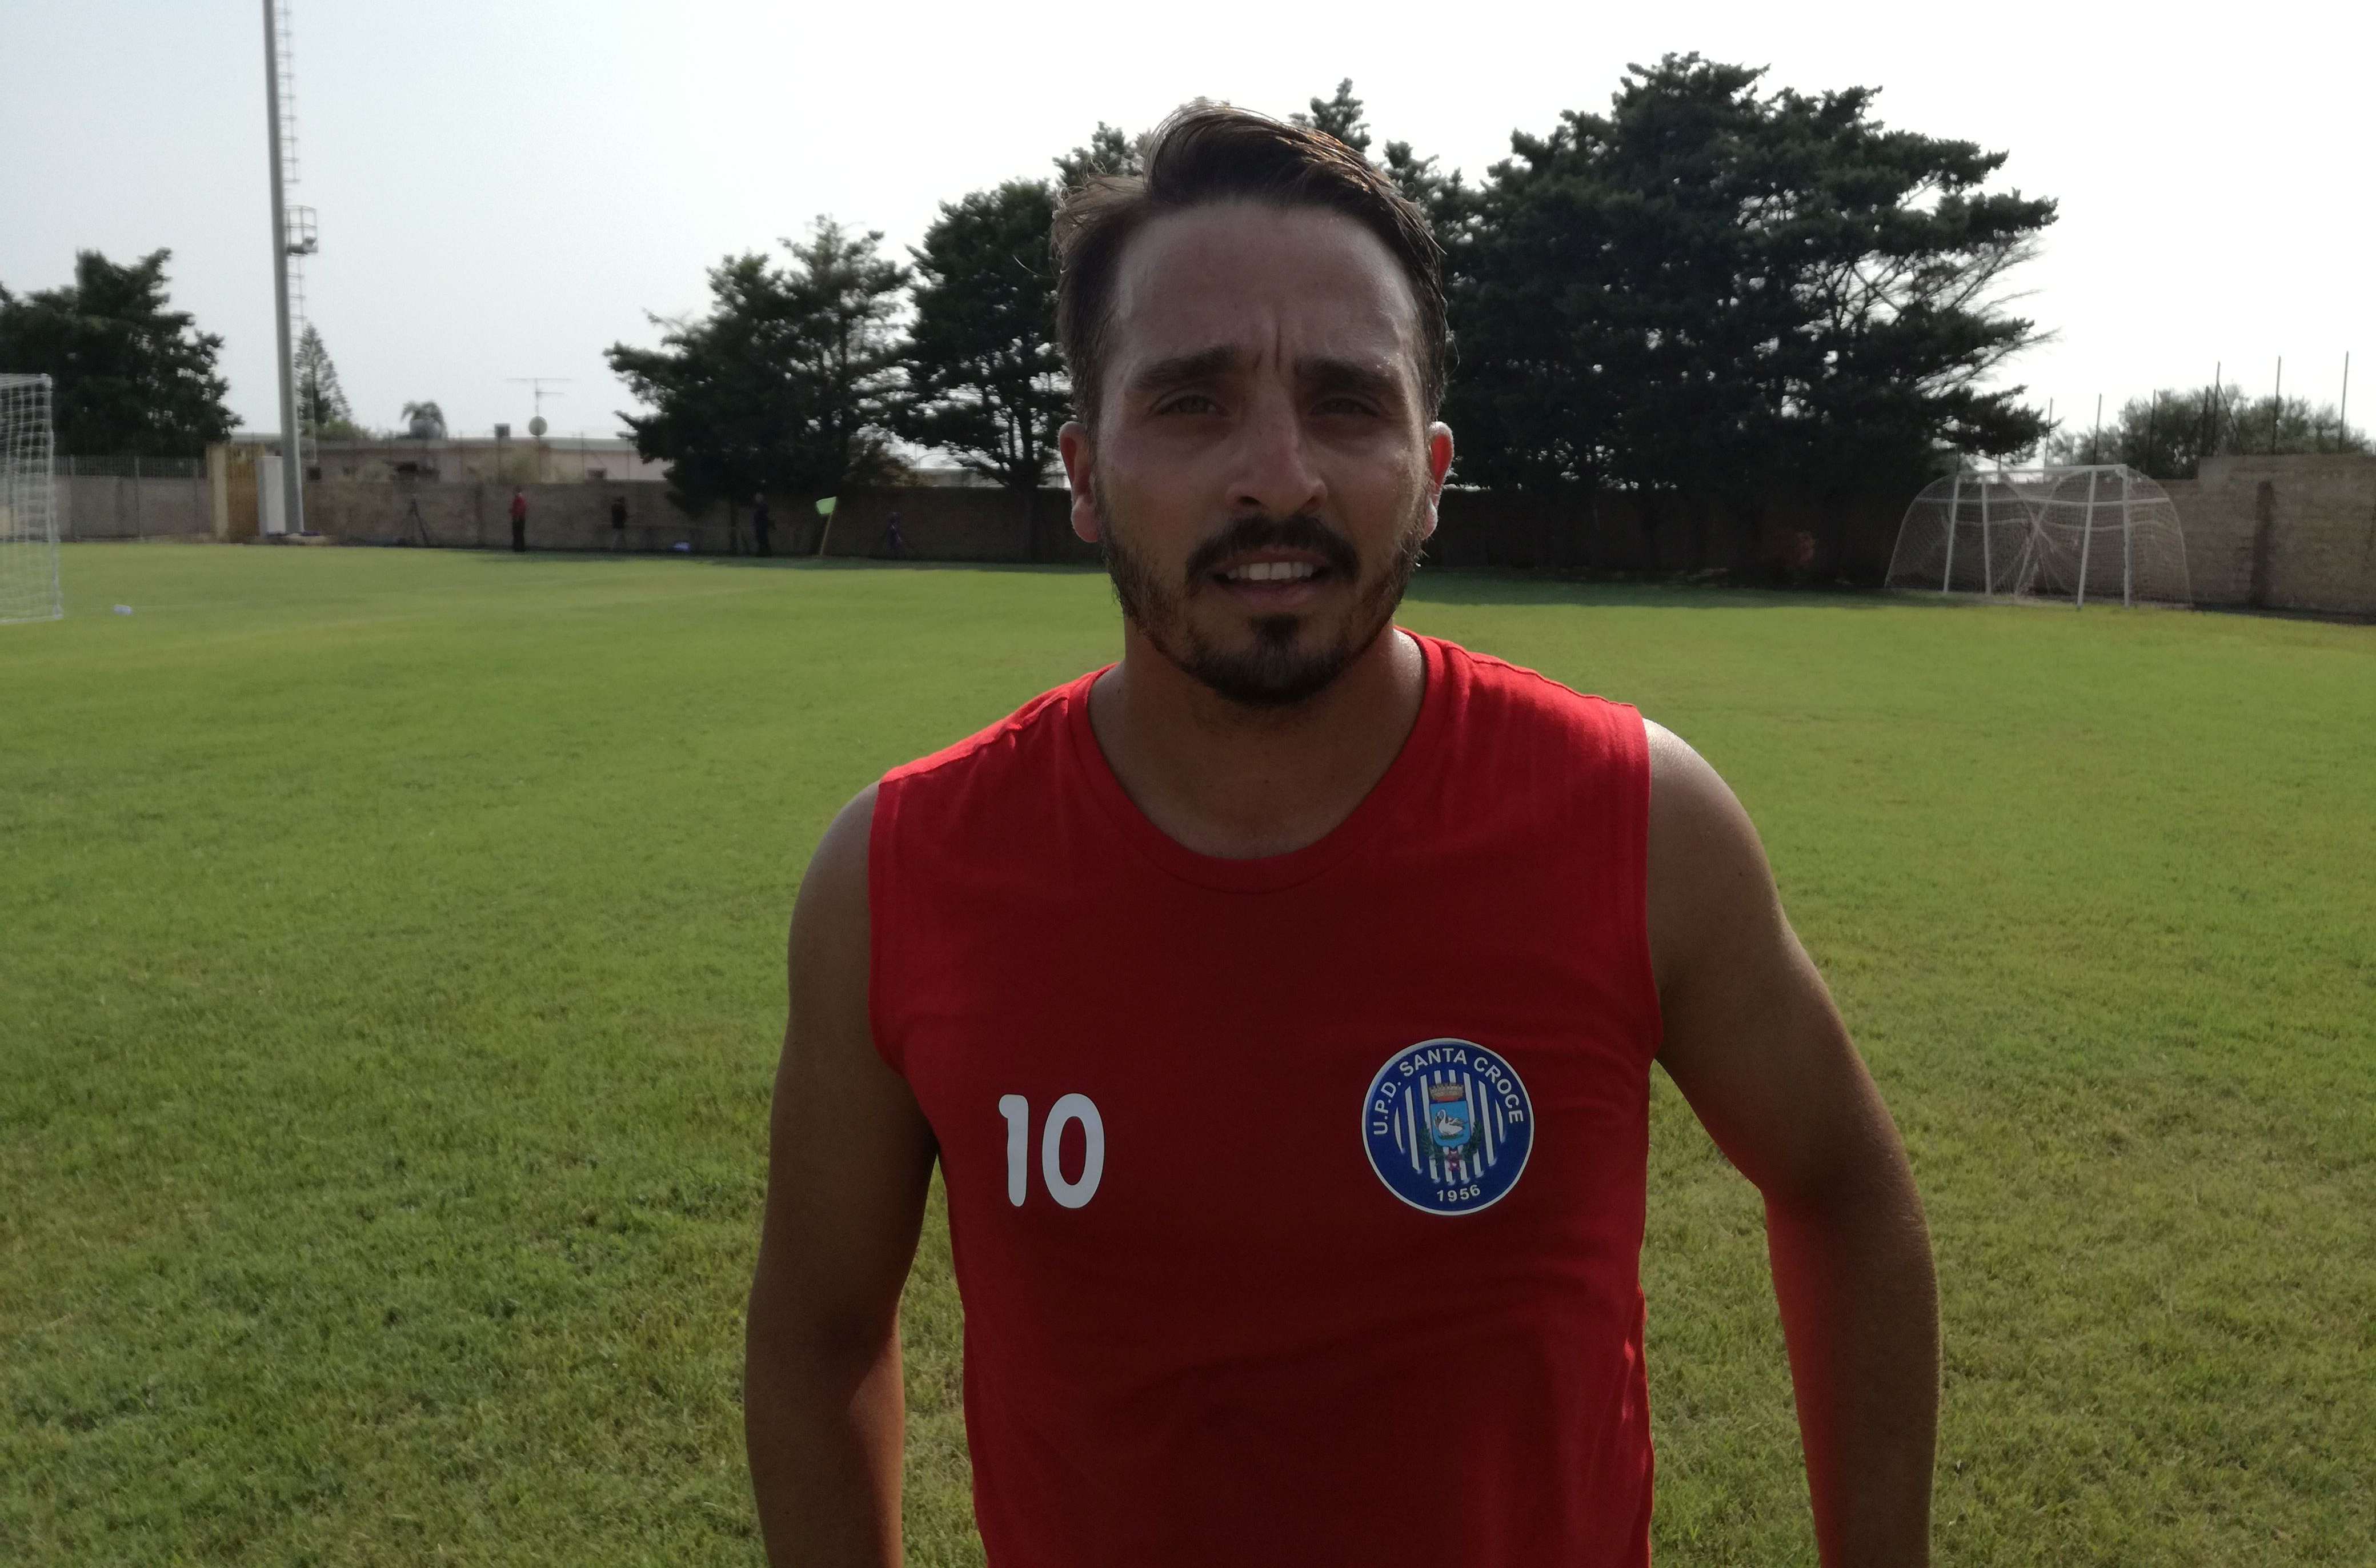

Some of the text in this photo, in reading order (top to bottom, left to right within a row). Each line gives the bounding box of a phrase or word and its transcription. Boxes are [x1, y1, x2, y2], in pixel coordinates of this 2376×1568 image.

[1373, 1048, 1524, 1135] U.P.D. SANTA CROCE
[999, 1093, 1105, 1209] 10
[1437, 1184, 1481, 1202] 1956
